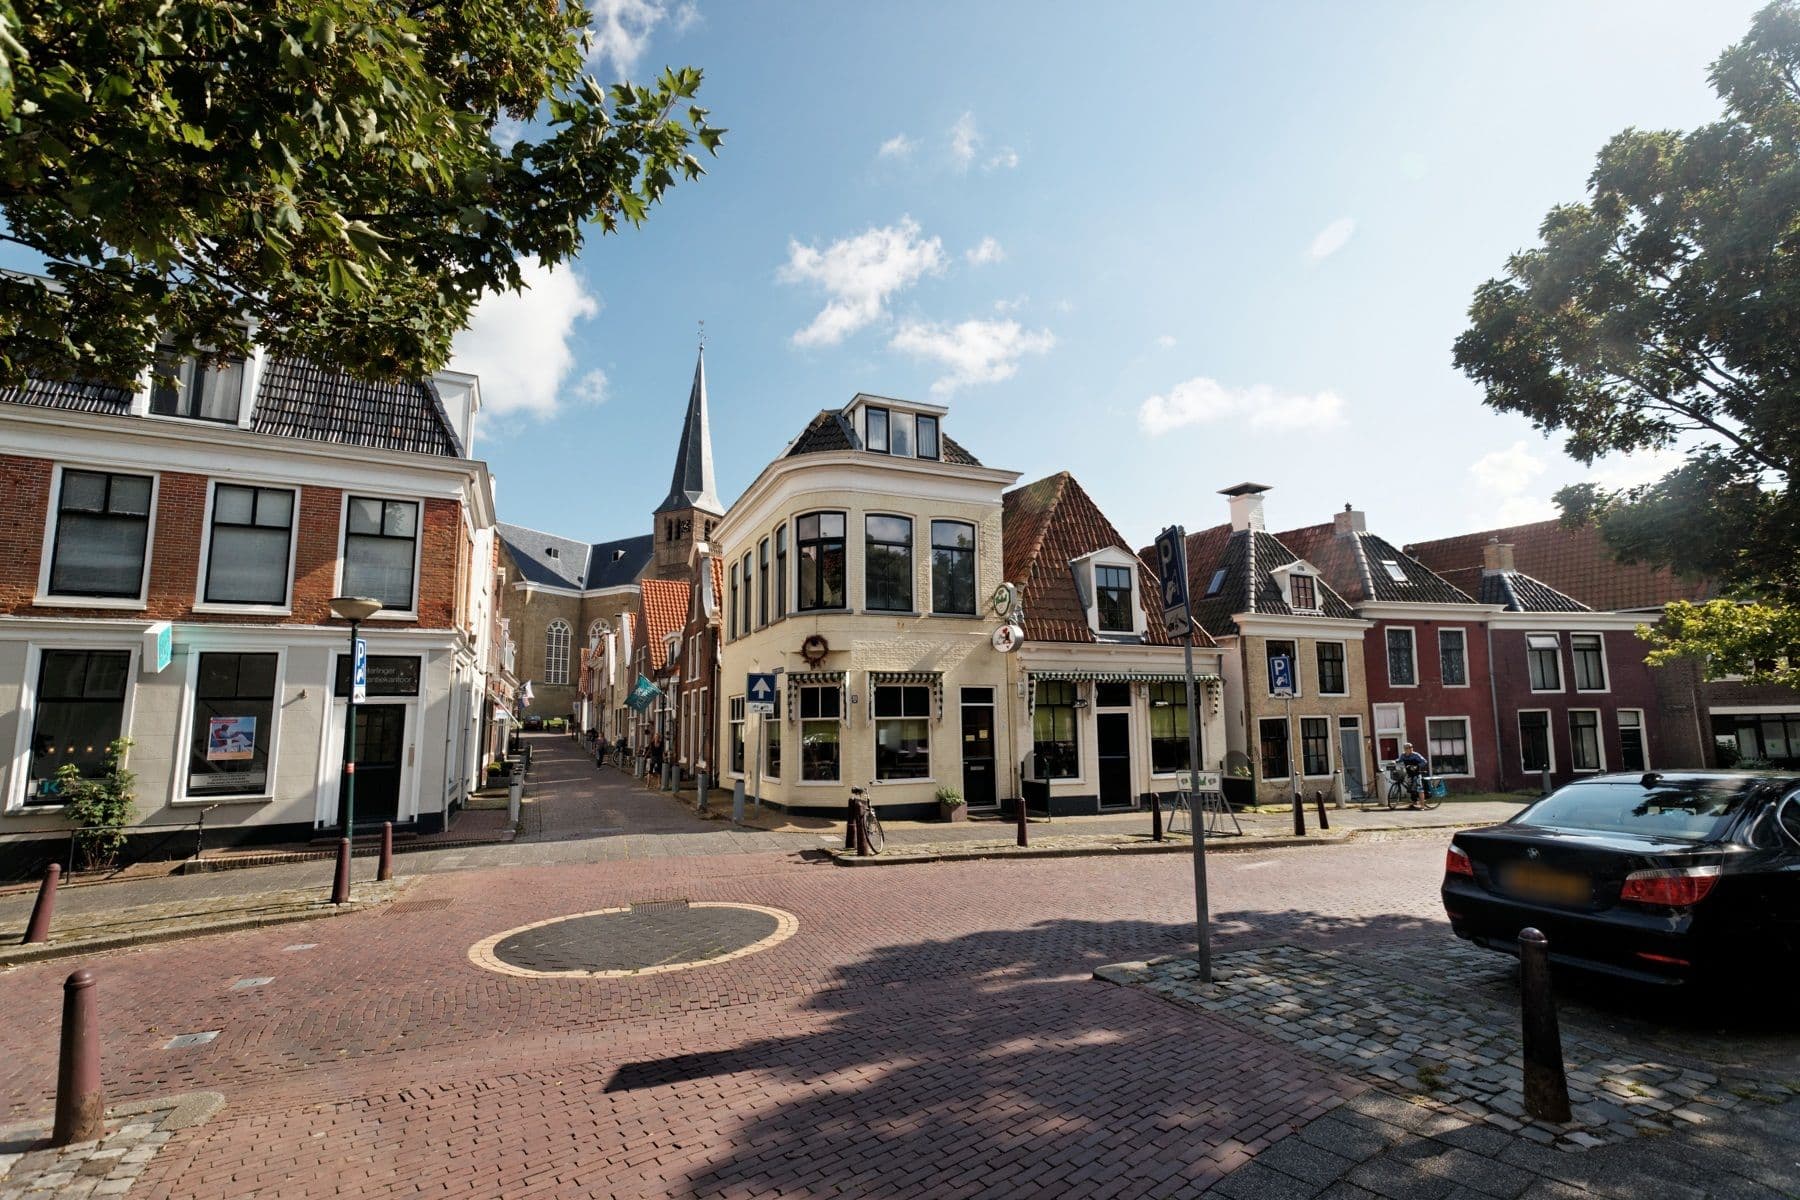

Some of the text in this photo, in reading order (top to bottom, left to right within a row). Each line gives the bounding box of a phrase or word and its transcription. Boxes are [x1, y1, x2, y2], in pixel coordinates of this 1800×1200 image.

[1160, 539, 1172, 577] P
[358, 643, 364, 666] P
[1274, 660, 1285, 675] P
